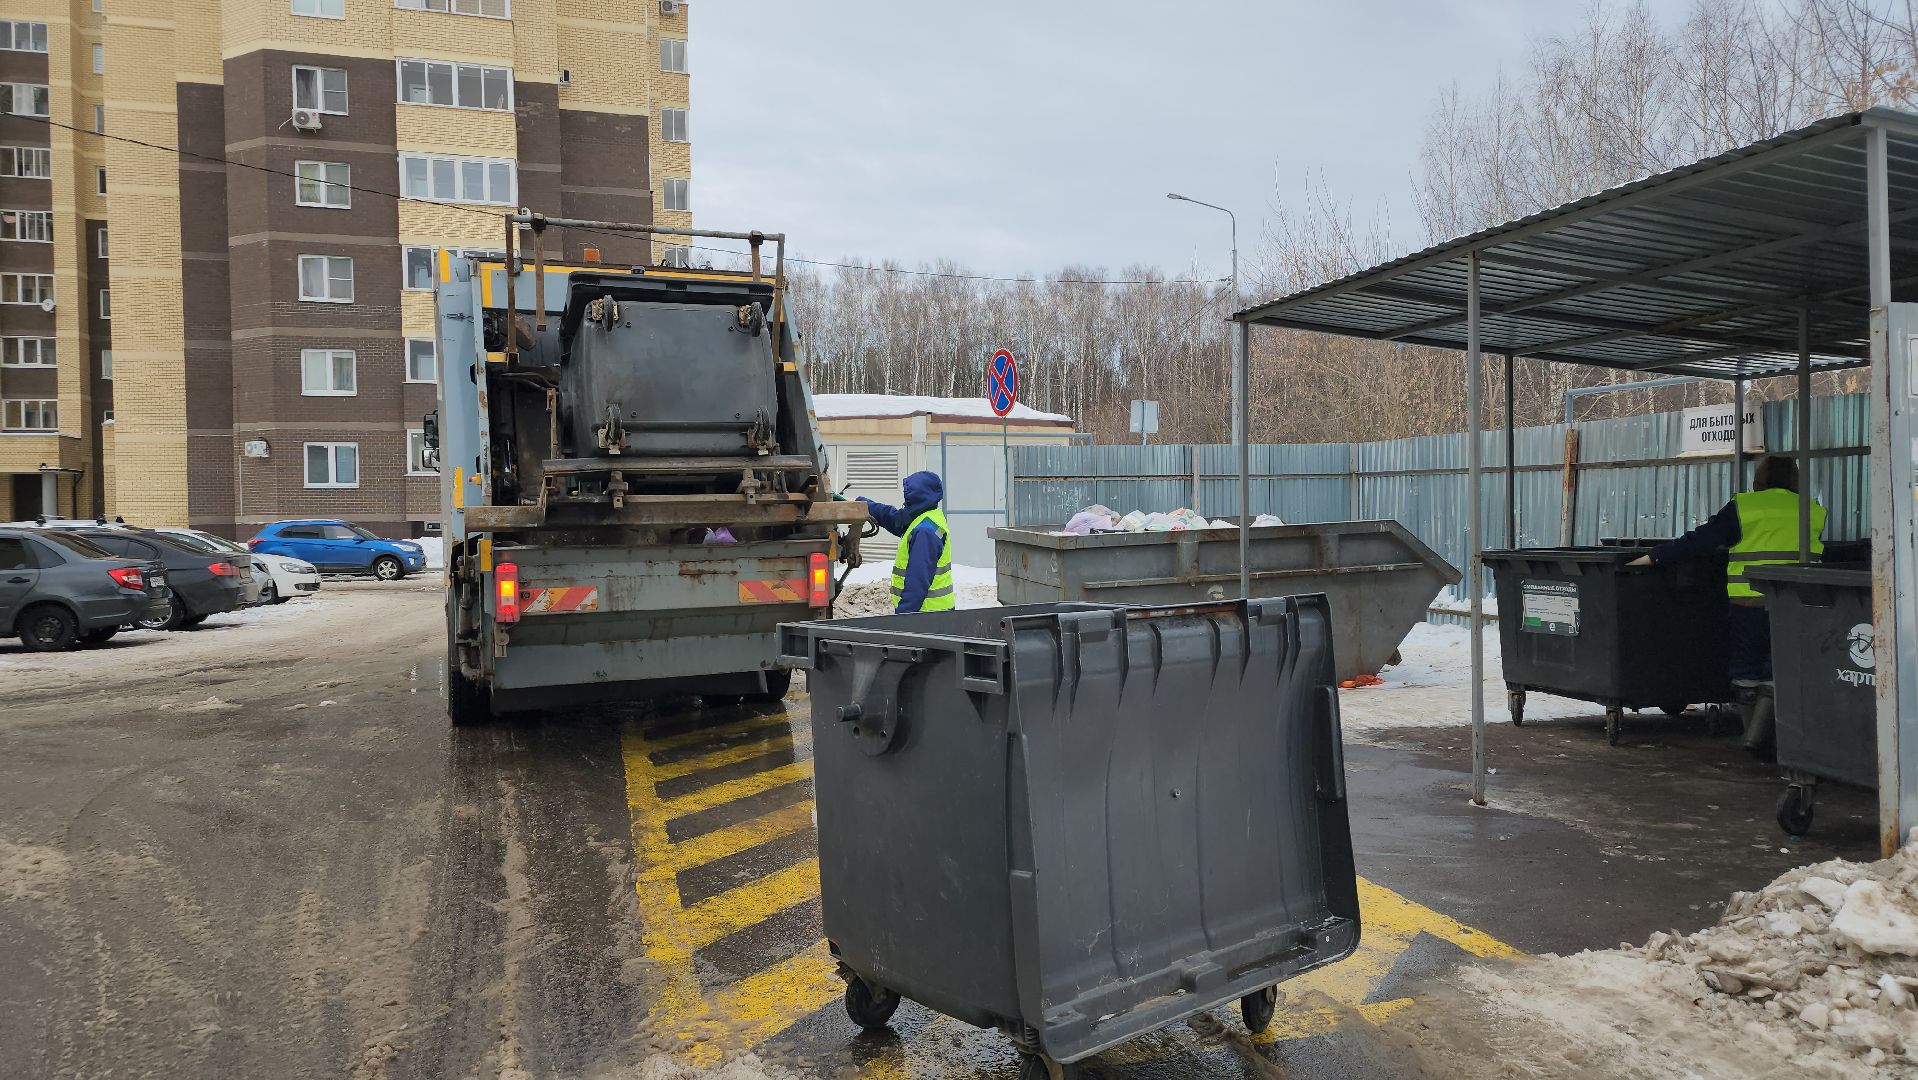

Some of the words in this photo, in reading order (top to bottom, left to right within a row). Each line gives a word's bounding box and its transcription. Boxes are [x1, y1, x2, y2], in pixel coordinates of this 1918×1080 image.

[1689, 417, 1708, 430] ДЛЯ
[1709, 412, 1755, 428] БЫТОЫХ
[1701, 429, 1736, 443] ОТХОДО
